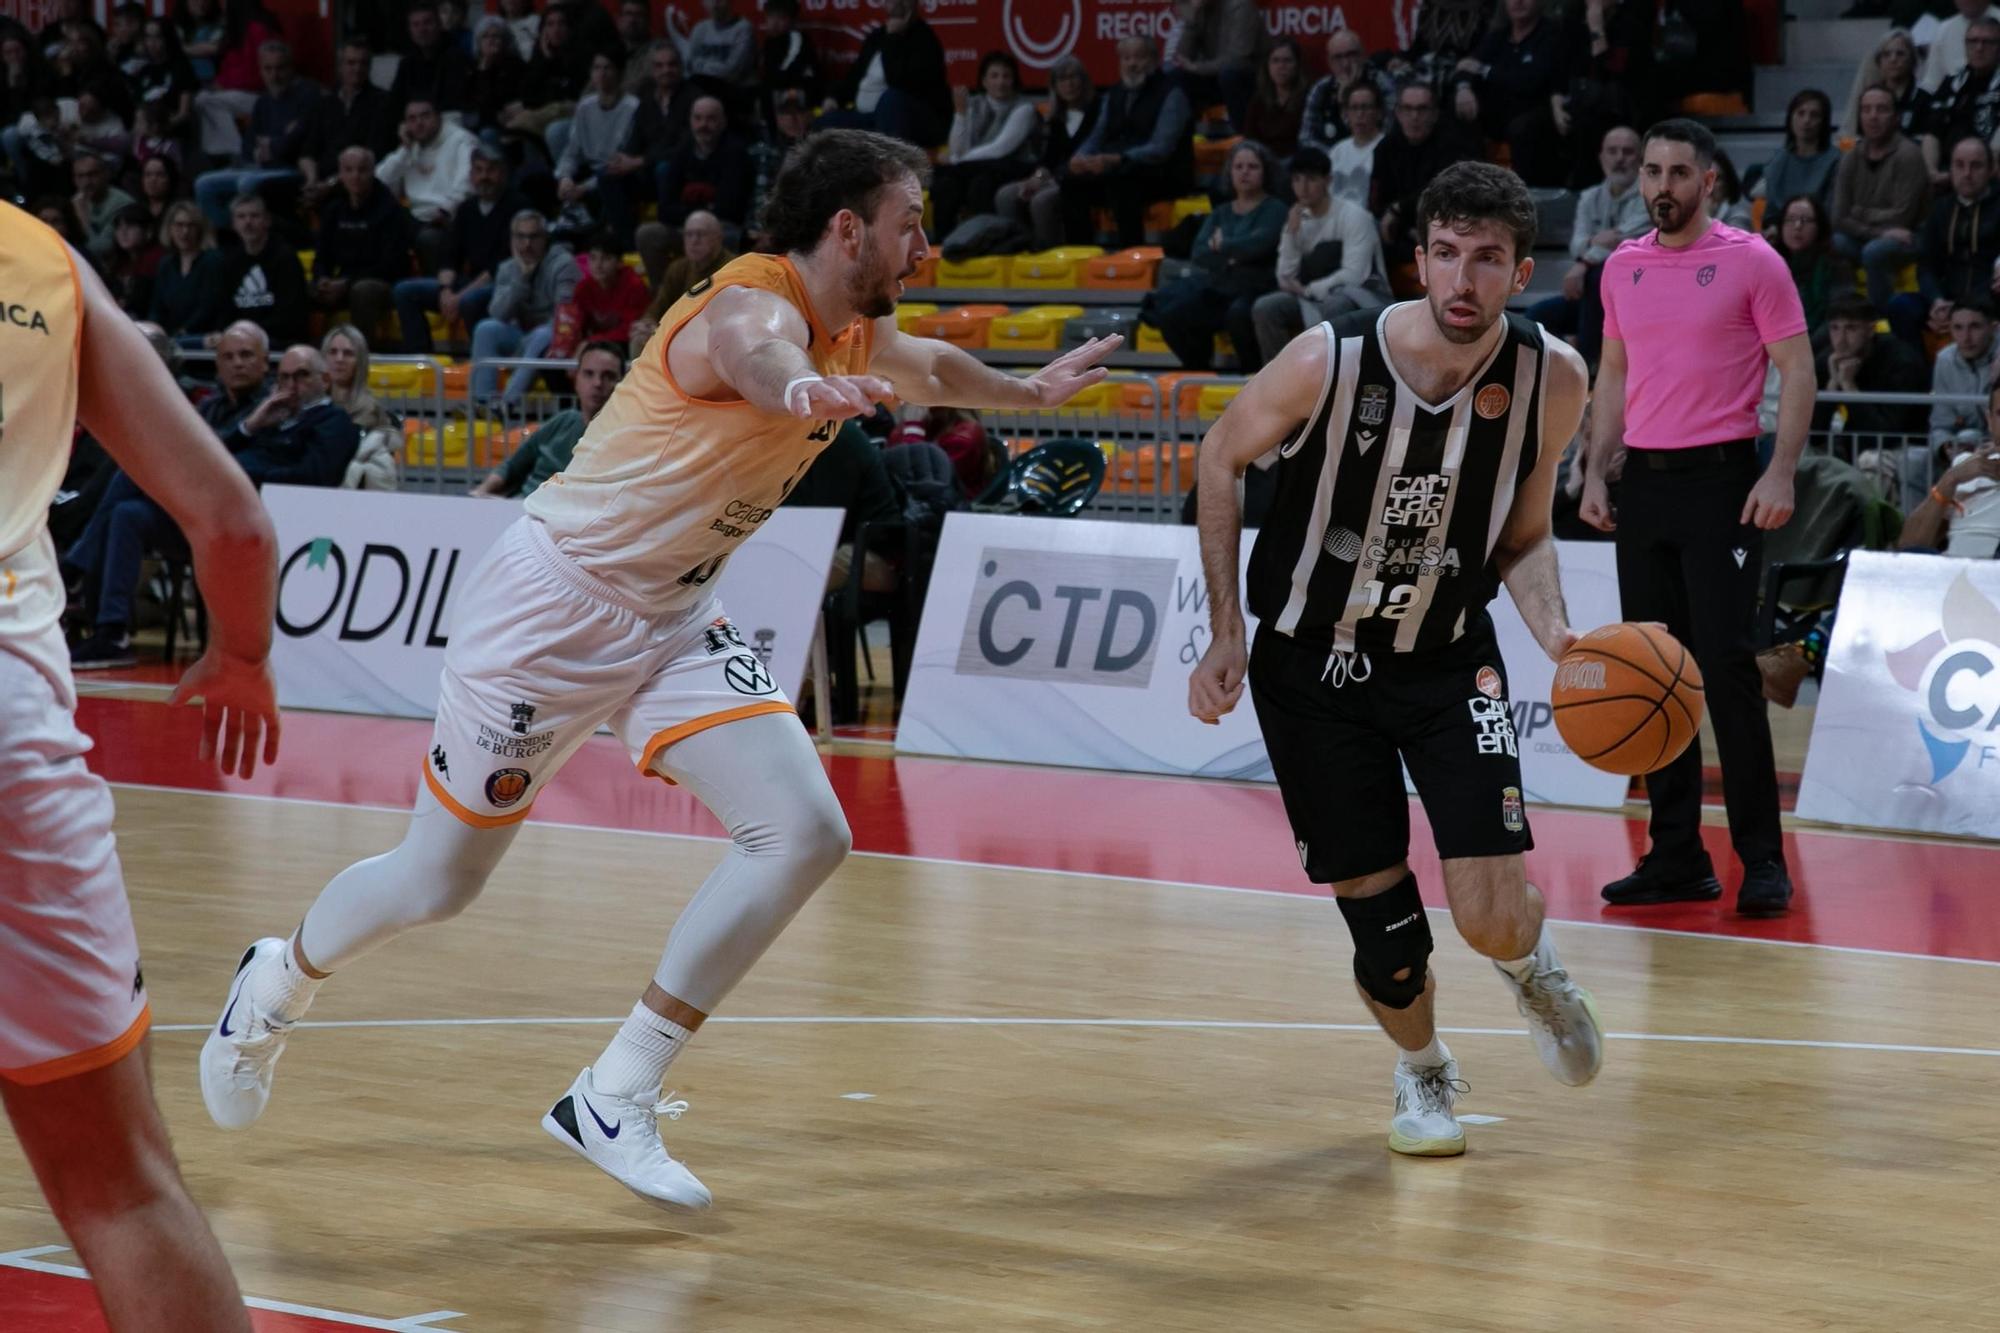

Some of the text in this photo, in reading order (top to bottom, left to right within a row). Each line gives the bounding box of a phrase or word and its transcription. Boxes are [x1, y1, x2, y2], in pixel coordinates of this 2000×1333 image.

[1097, 7, 1347, 39] REGIÓ URCIA
[1371, 536, 1440, 548] GRUPO
[1362, 559, 1460, 577] SEGUROS
[1366, 545, 1461, 568] CAESA
[1178, 576, 1209, 613] W
[1358, 580, 1421, 620] 12
[978, 580, 1157, 672] CTD
[1929, 651, 2000, 731] C
[476, 735, 553, 758] DE BURGOS
[480, 724, 555, 747] UNIVERSIDAD
